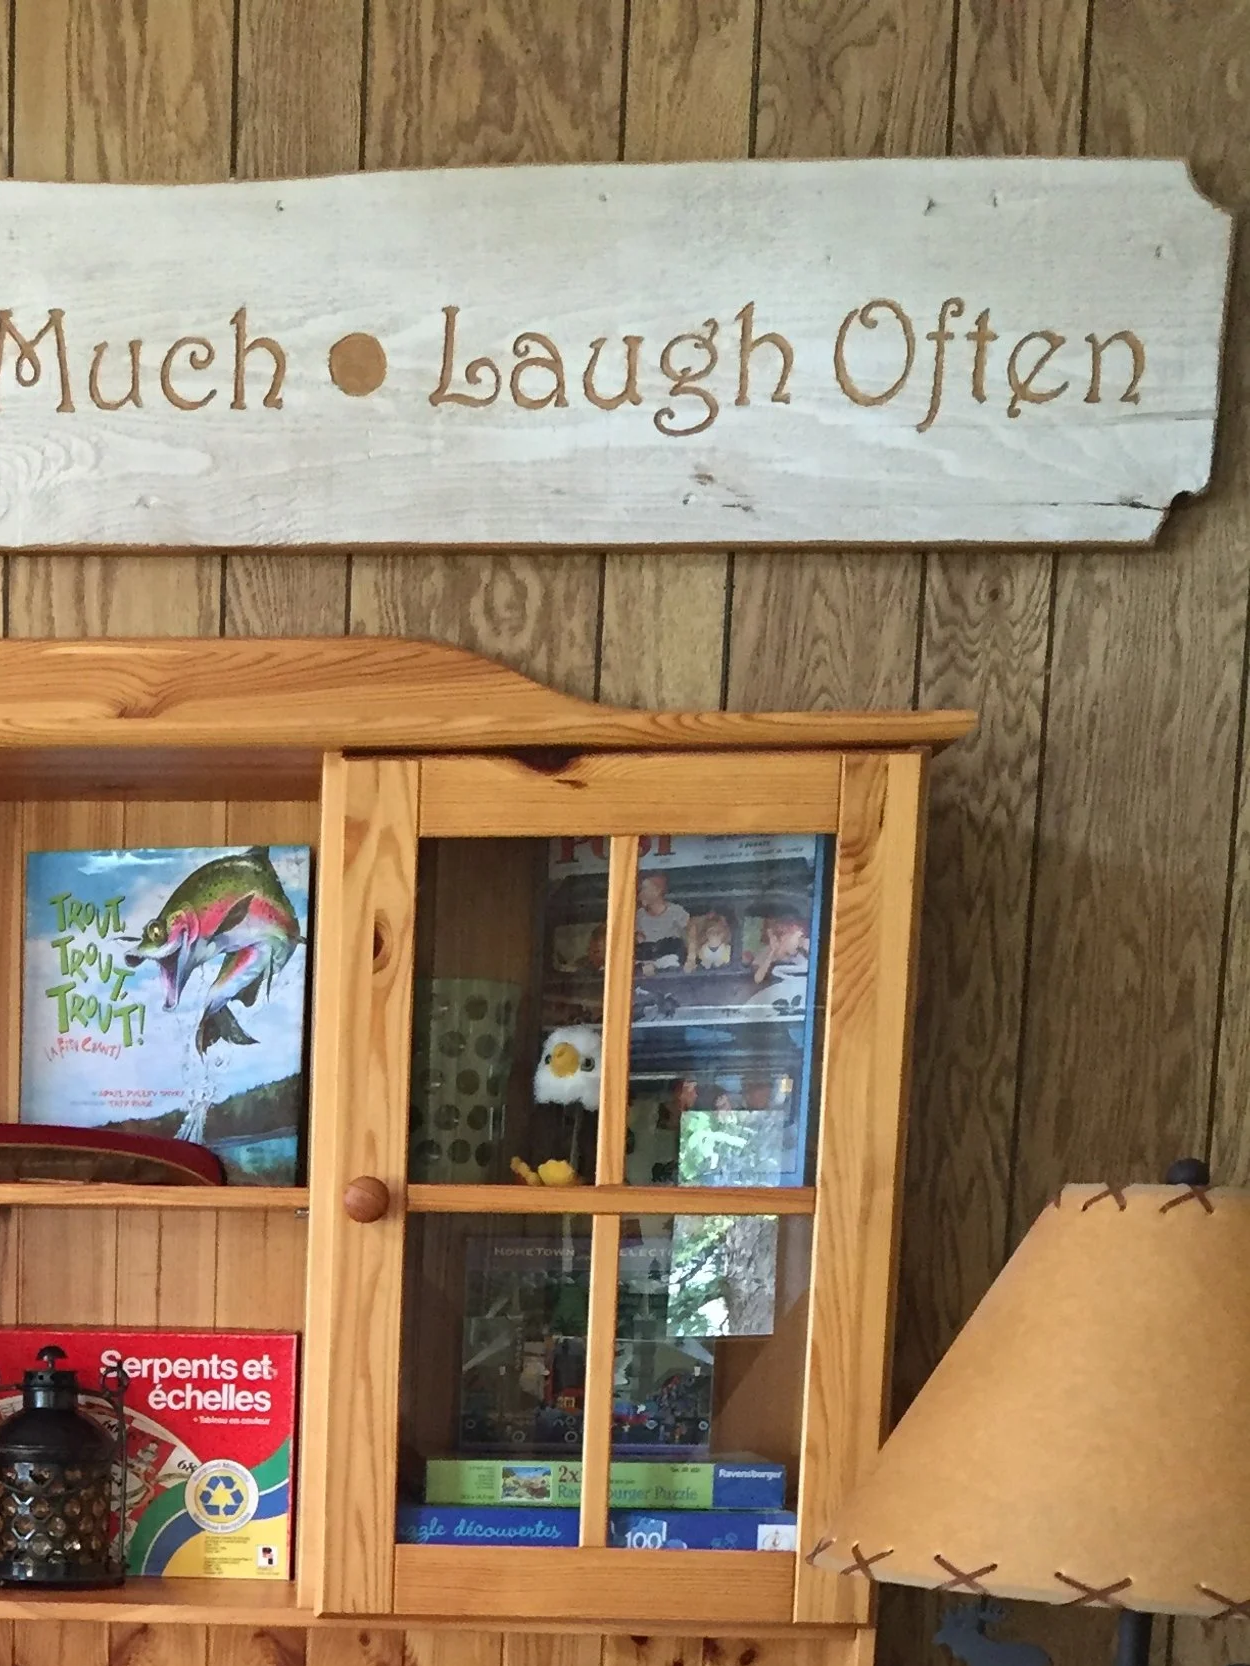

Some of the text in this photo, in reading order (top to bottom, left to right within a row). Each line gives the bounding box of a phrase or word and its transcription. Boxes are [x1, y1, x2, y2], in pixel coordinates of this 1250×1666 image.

[429, 299, 795, 437] Laugh
[834, 296, 1147, 433] Often
[49, 892, 126, 938] TROUT,
[51, 935, 136, 1001] TROUT,
[45, 981, 146, 1047] TROUT!
[100, 1349, 273, 1383] Serpents et
[148, 1383, 271, 1411] échelles
[719, 1469, 783, 1481] Ravensburger
[453, 1518, 561, 1540] découvertes
